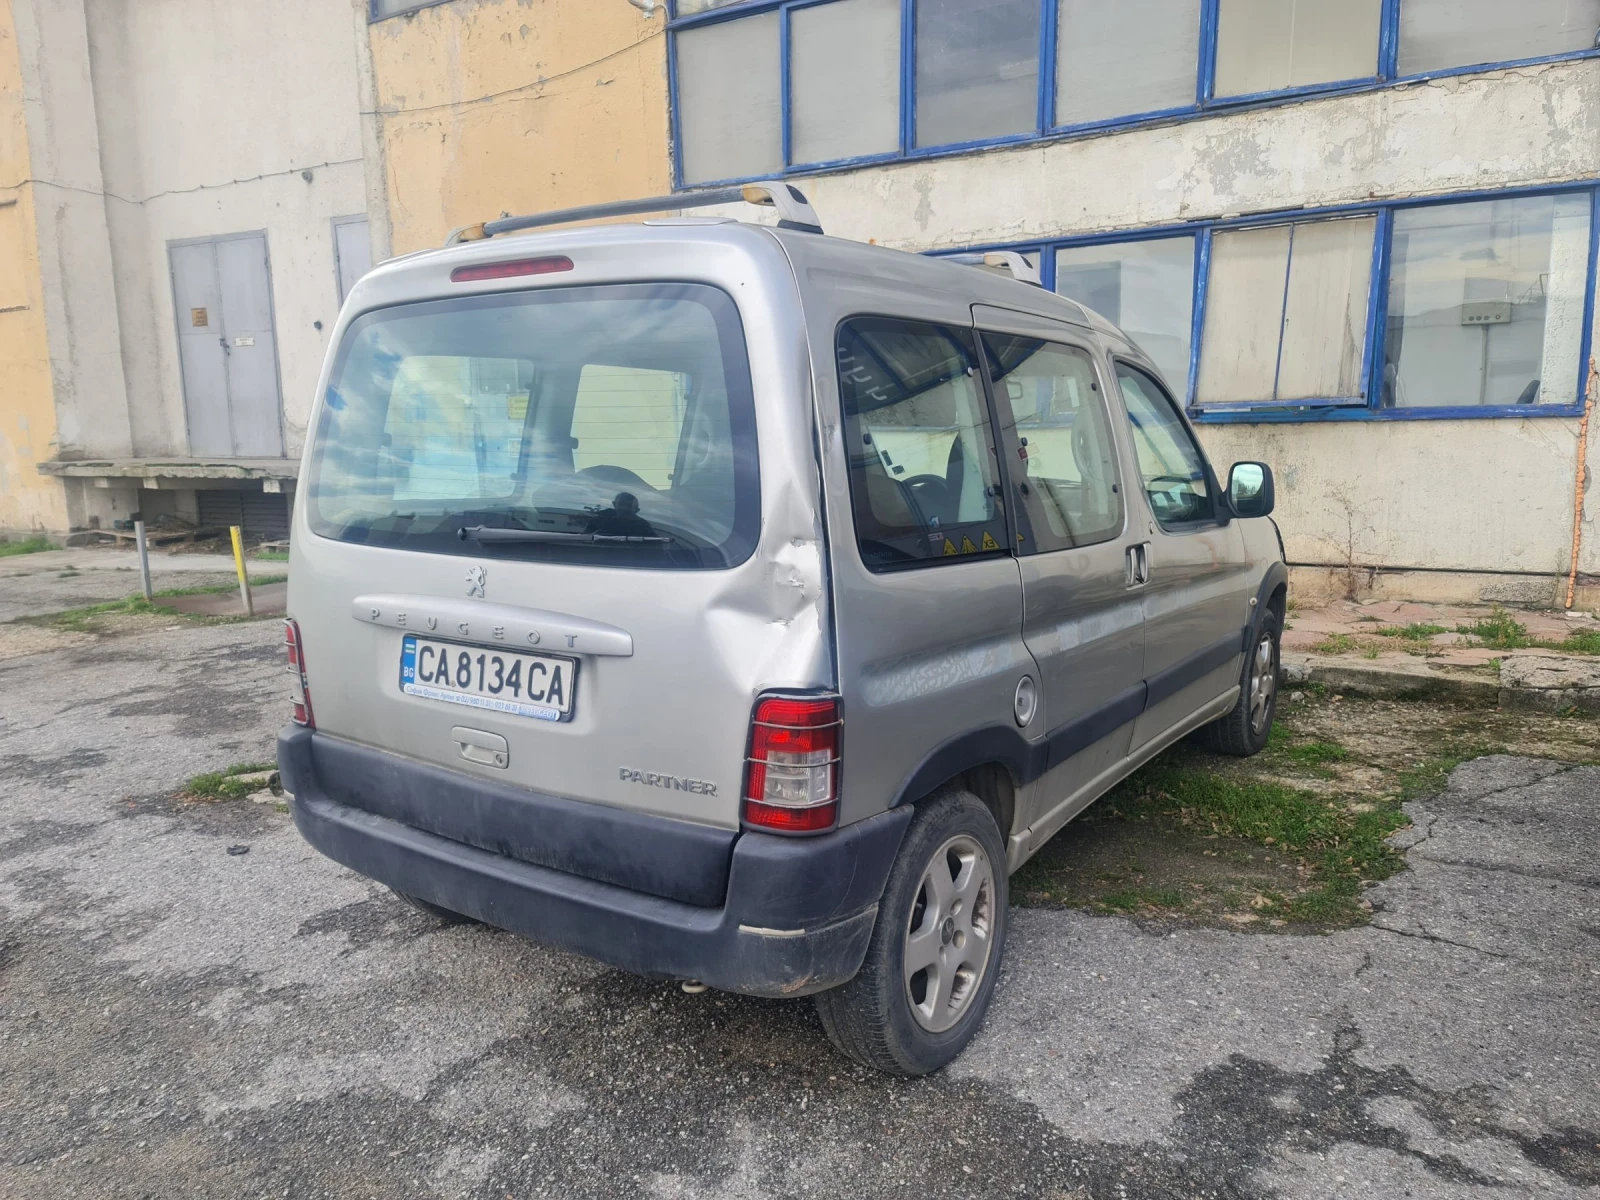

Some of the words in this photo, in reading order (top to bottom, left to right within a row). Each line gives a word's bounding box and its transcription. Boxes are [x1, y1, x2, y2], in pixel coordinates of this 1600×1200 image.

[370, 607, 577, 648] PEUGEOT
[403, 665, 415, 679] BG
[619, 766, 718, 797] PARTNER
